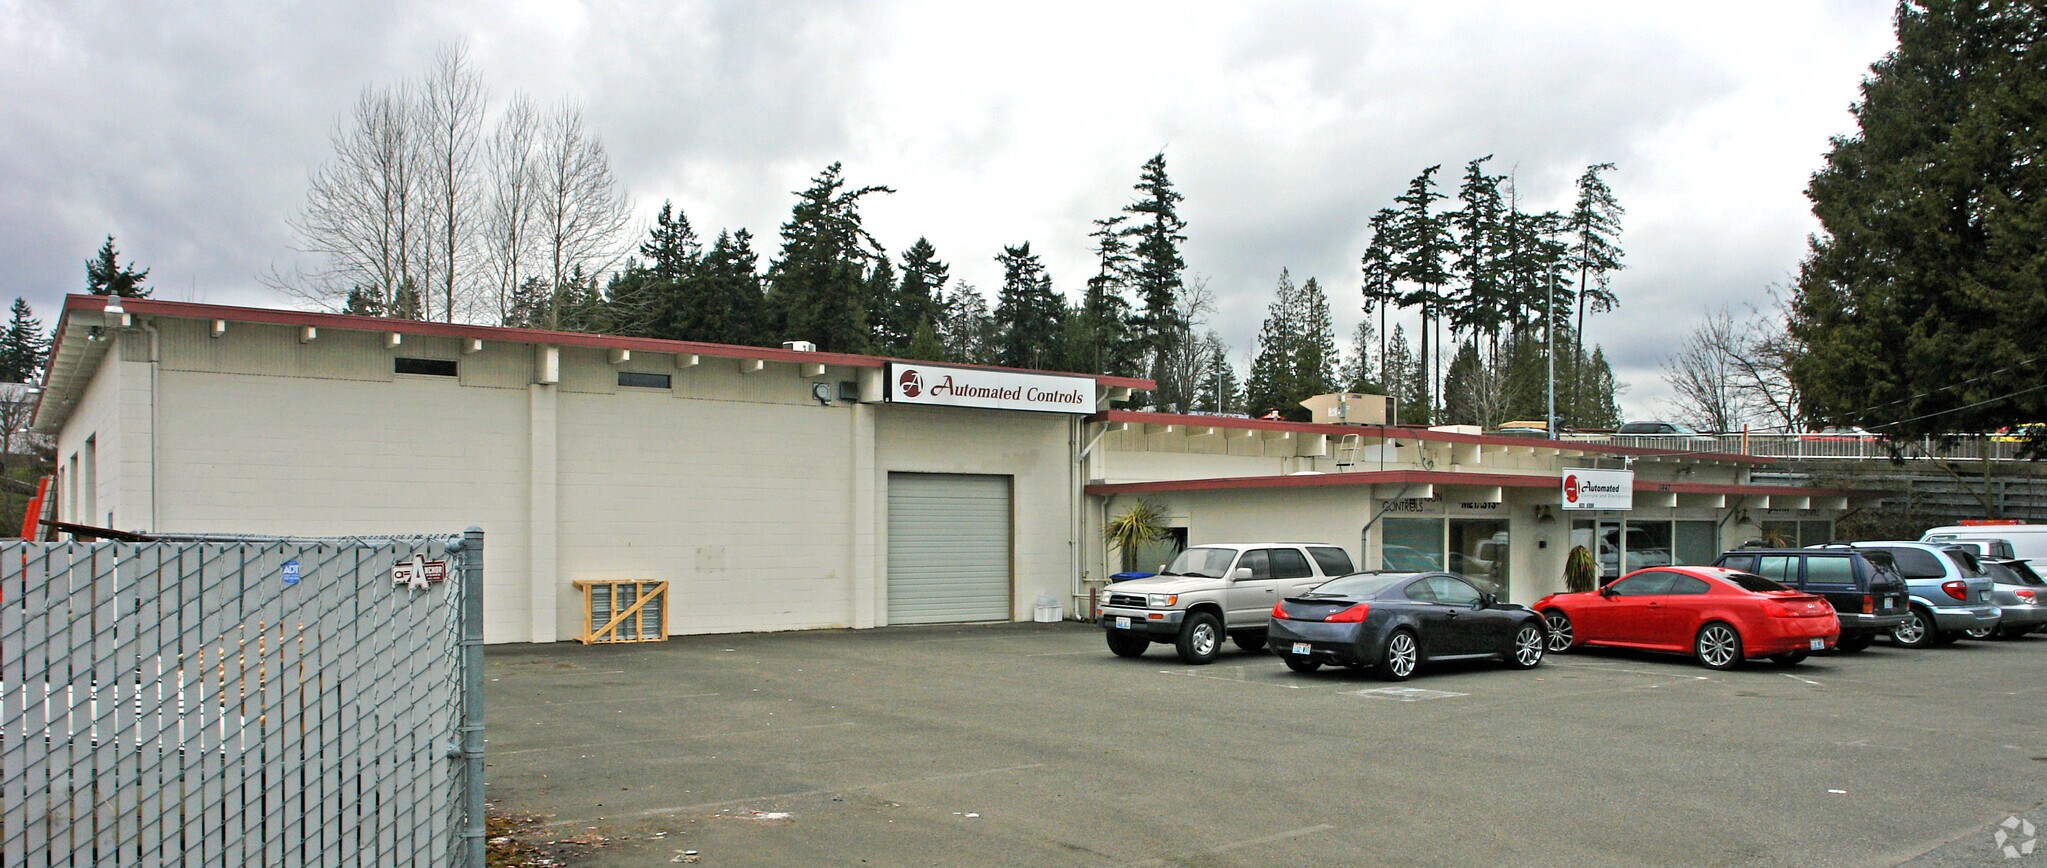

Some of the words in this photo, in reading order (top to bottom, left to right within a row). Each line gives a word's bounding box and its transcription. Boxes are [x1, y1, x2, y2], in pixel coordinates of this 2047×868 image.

[930, 375, 1021, 400] Automated
[1027, 387, 1084, 404] Controls
[1581, 480, 1620, 493] Automated
[1382, 501, 1424, 512] CONTROLS
[283, 565, 300, 574] ADT
